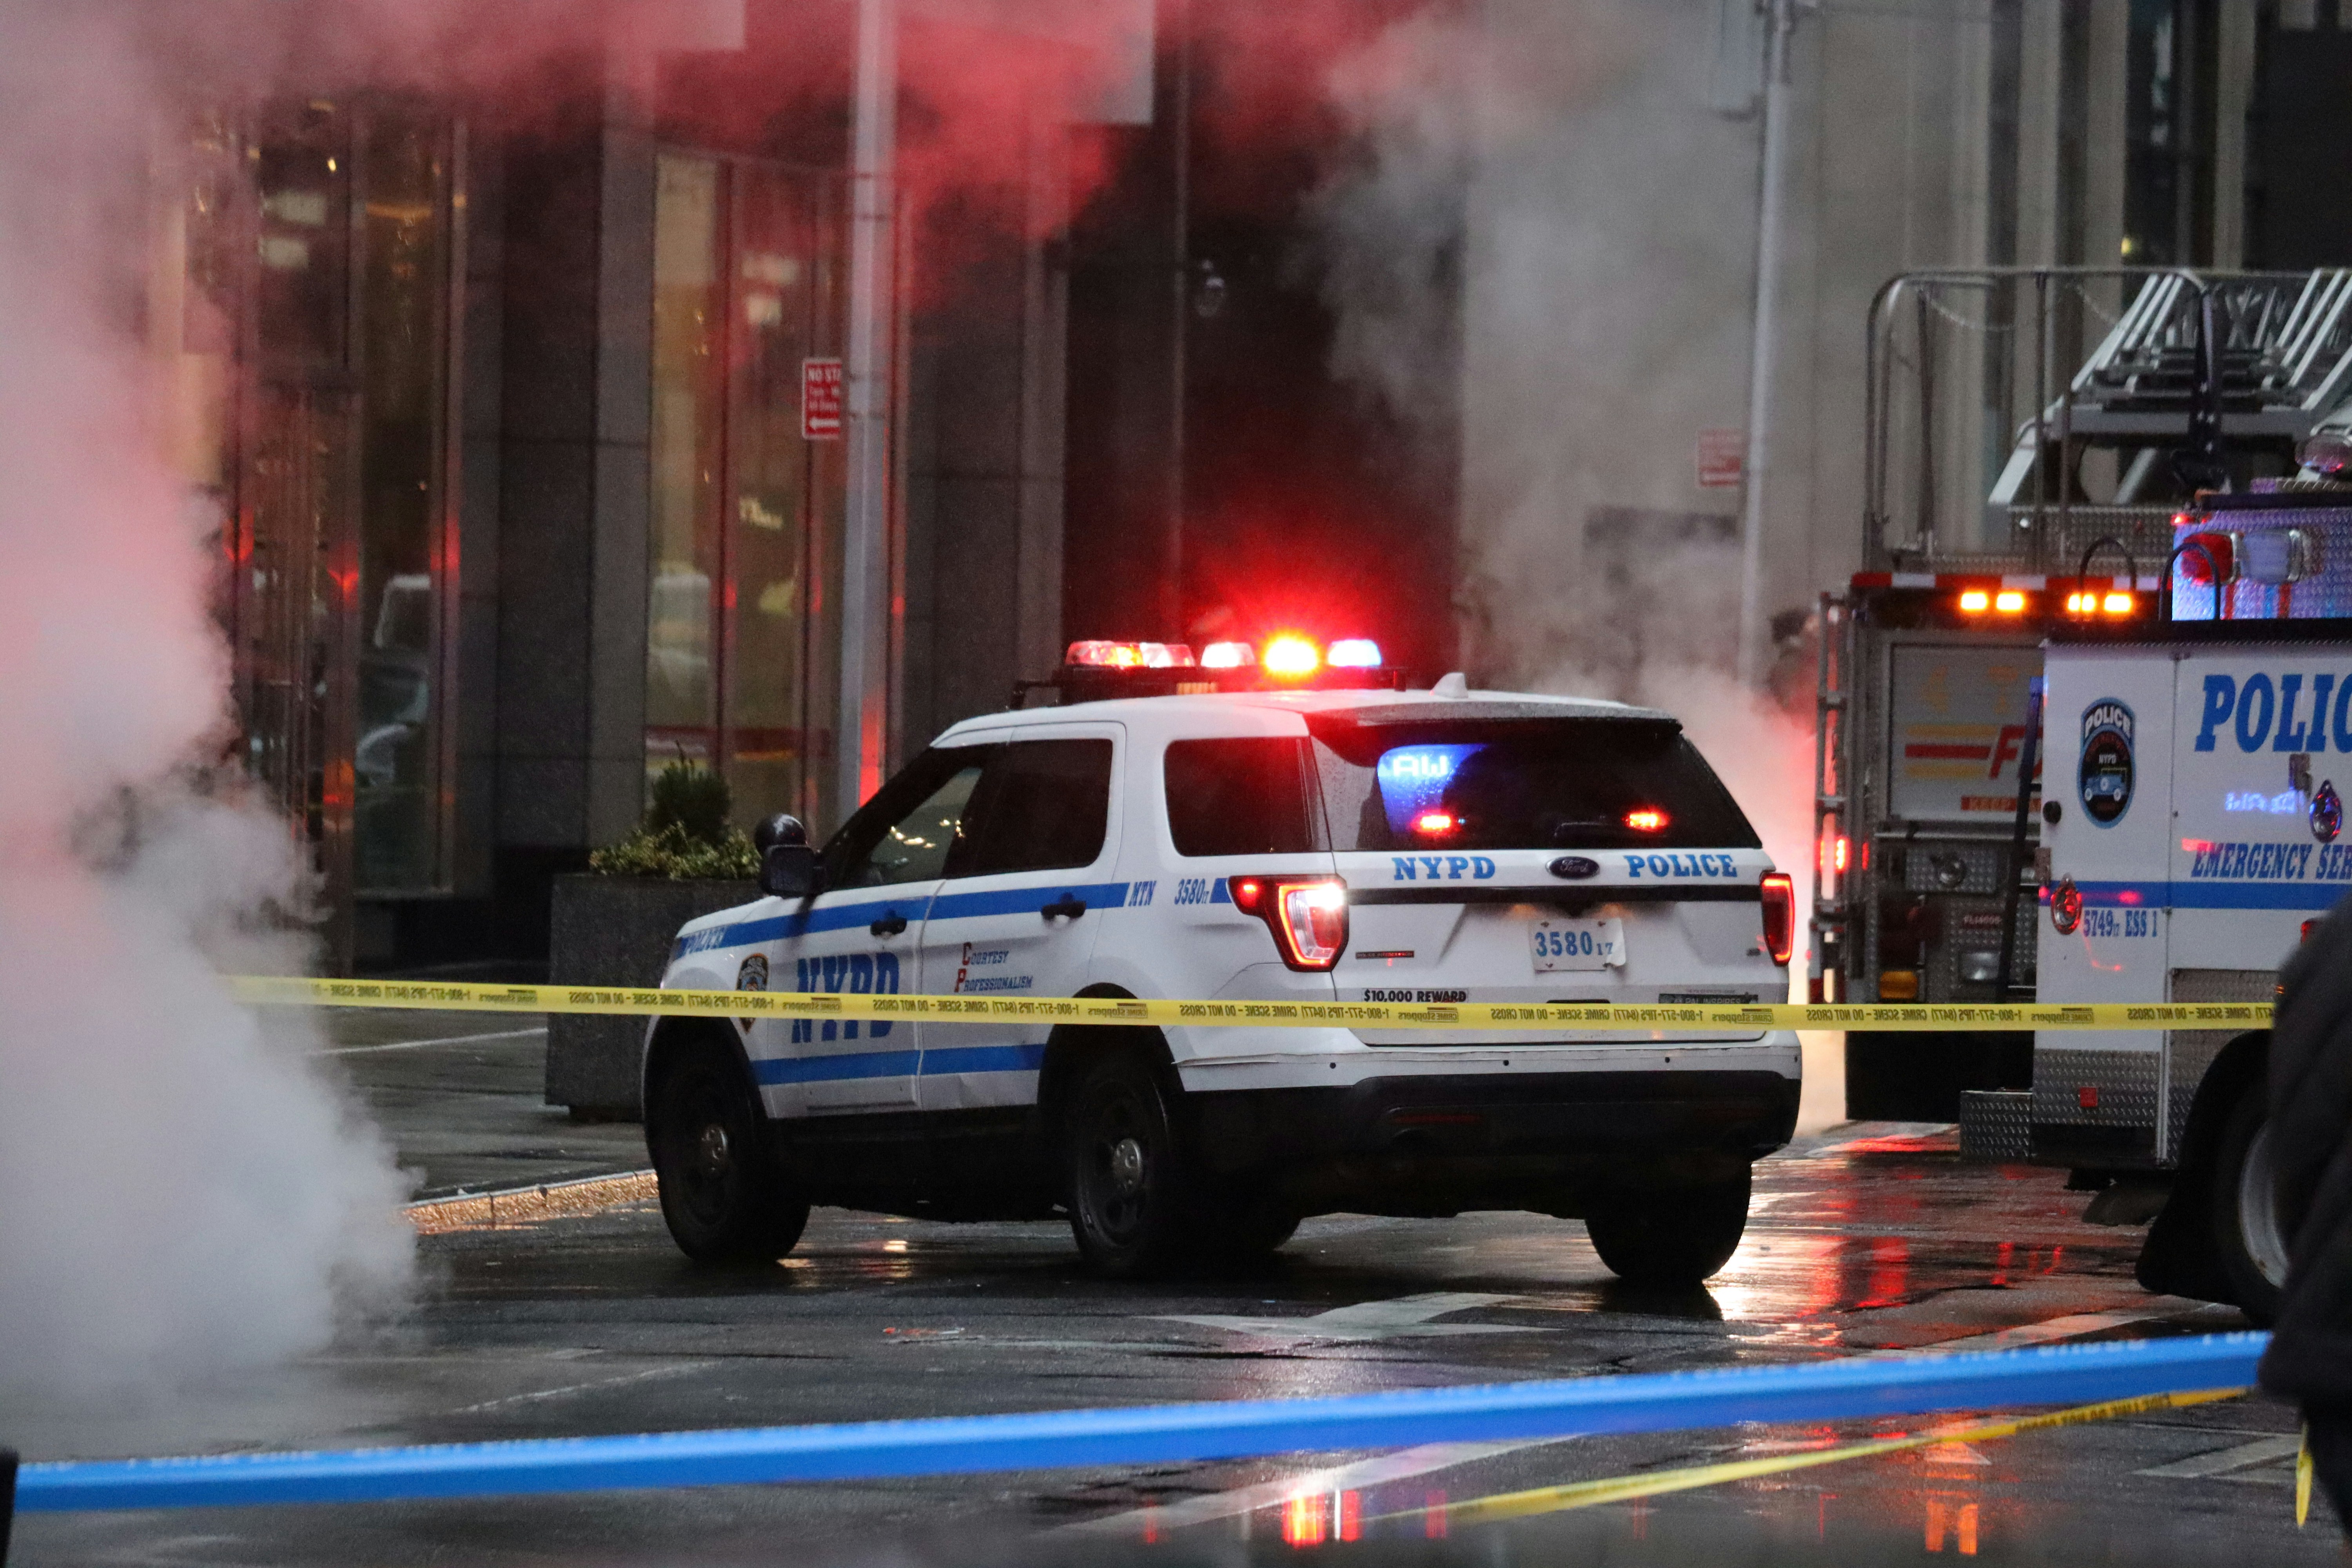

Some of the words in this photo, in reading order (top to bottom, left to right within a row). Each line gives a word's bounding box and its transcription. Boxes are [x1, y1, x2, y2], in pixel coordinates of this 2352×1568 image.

[2085, 705, 2131, 739] POLICE
[2098, 753, 2117, 764] NYPD
[1393, 857, 1495, 880] NYPD
[1627, 854, 1738, 878] POLICE
[2191, 843, 2312, 879] EMERGENCY
[1128, 880, 1156, 906] MTN
[2125, 910, 2146, 937] ESS
[962, 942, 1009, 965] COURTESY
[1535, 931, 1592, 956] 3580
[954, 968, 1033, 992] PROFESSIONALISM
[791, 952, 899, 1043] NYPD
[1364, 989, 1412, 1002] $10,000
[1417, 991, 1466, 1003] REWARD
